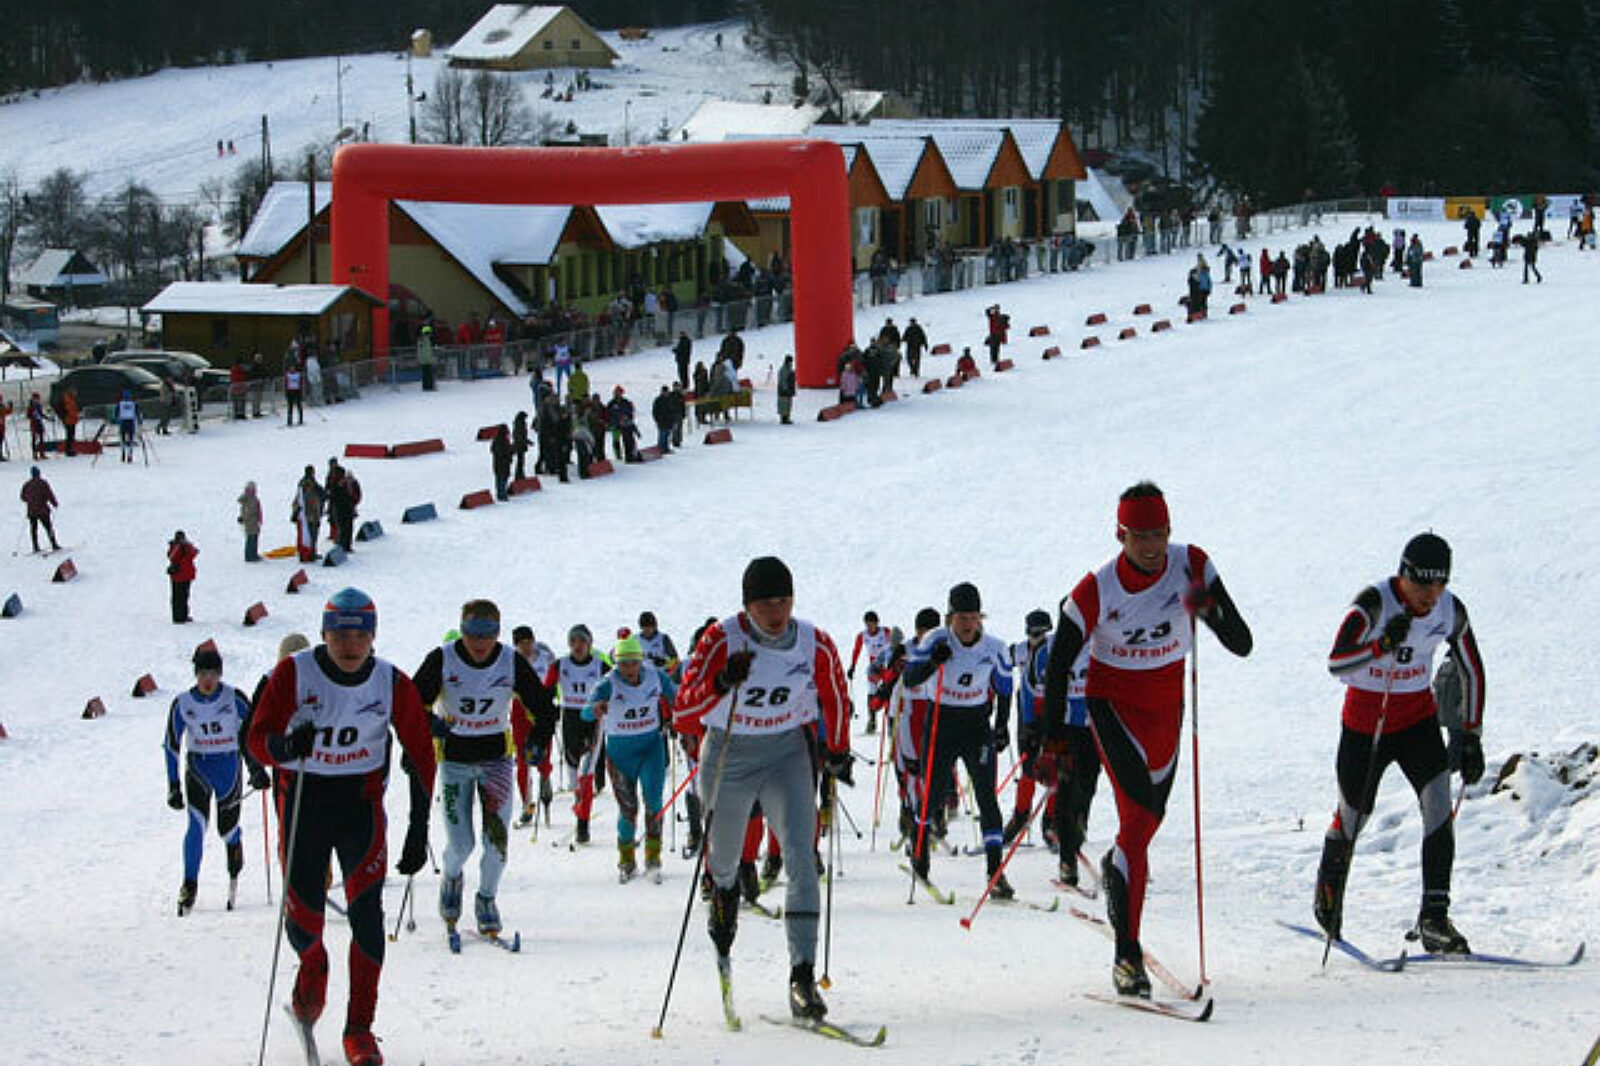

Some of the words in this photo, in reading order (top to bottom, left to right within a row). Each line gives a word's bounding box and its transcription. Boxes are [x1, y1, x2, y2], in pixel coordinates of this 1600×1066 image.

[1122, 621, 1171, 645] 23
[1112, 639, 1180, 658] ISTEBNA
[459, 697, 495, 715] 37
[745, 686, 791, 707] 26
[732, 711, 793, 727] STEBNA
[315, 726, 358, 747] 10
[314, 746, 370, 765] TEBNA
